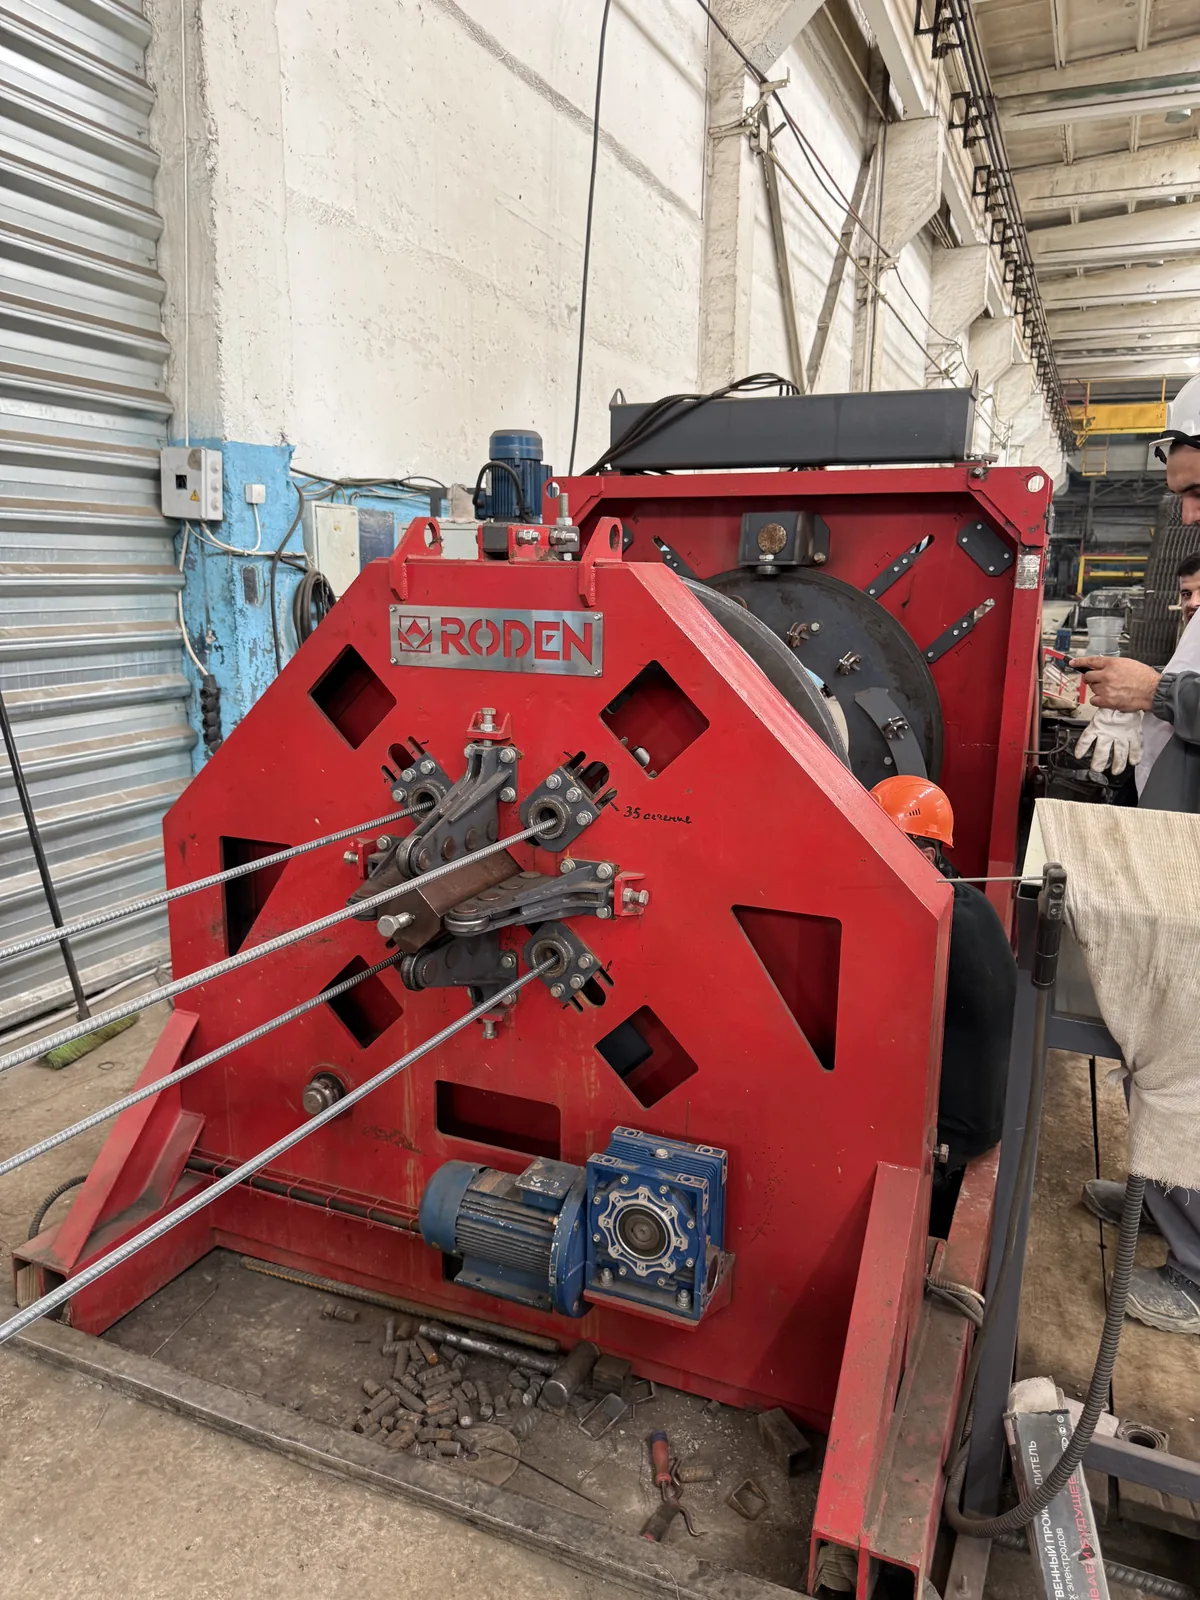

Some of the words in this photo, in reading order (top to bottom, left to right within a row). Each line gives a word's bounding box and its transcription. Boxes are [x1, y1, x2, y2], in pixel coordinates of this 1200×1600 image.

[440, 616, 593, 666] RODEN
[623, 805, 641, 820] 35
[1044, 1545, 1065, 1600] ВЕННЫЙ
[1056, 1527, 1075, 1592] электродов
